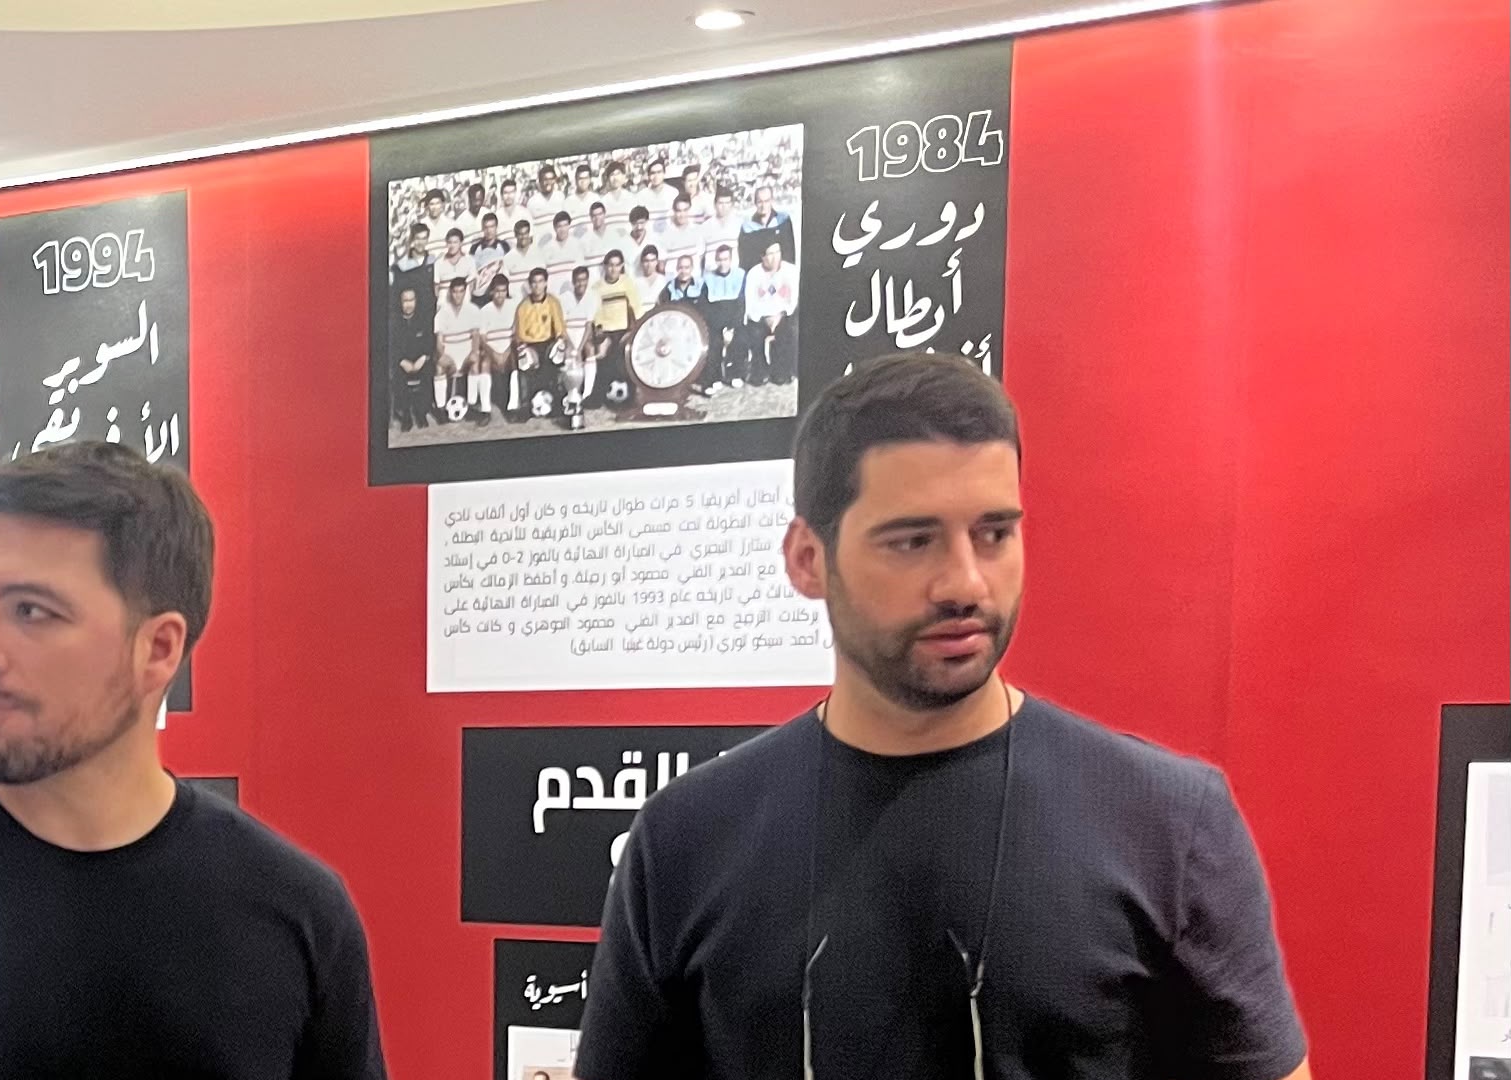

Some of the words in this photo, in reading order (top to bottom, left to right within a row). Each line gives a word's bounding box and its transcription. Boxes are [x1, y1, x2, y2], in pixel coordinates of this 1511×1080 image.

[847, 110, 1004, 182] 1984
[33, 229, 155, 295] 1994
[833, 200, 986, 267] دوري
[845, 248, 964, 351] أبطال
[42, 299, 161, 394] السوبر
[686, 495, 694, 508] 5
[633, 590, 664, 604] 1993
